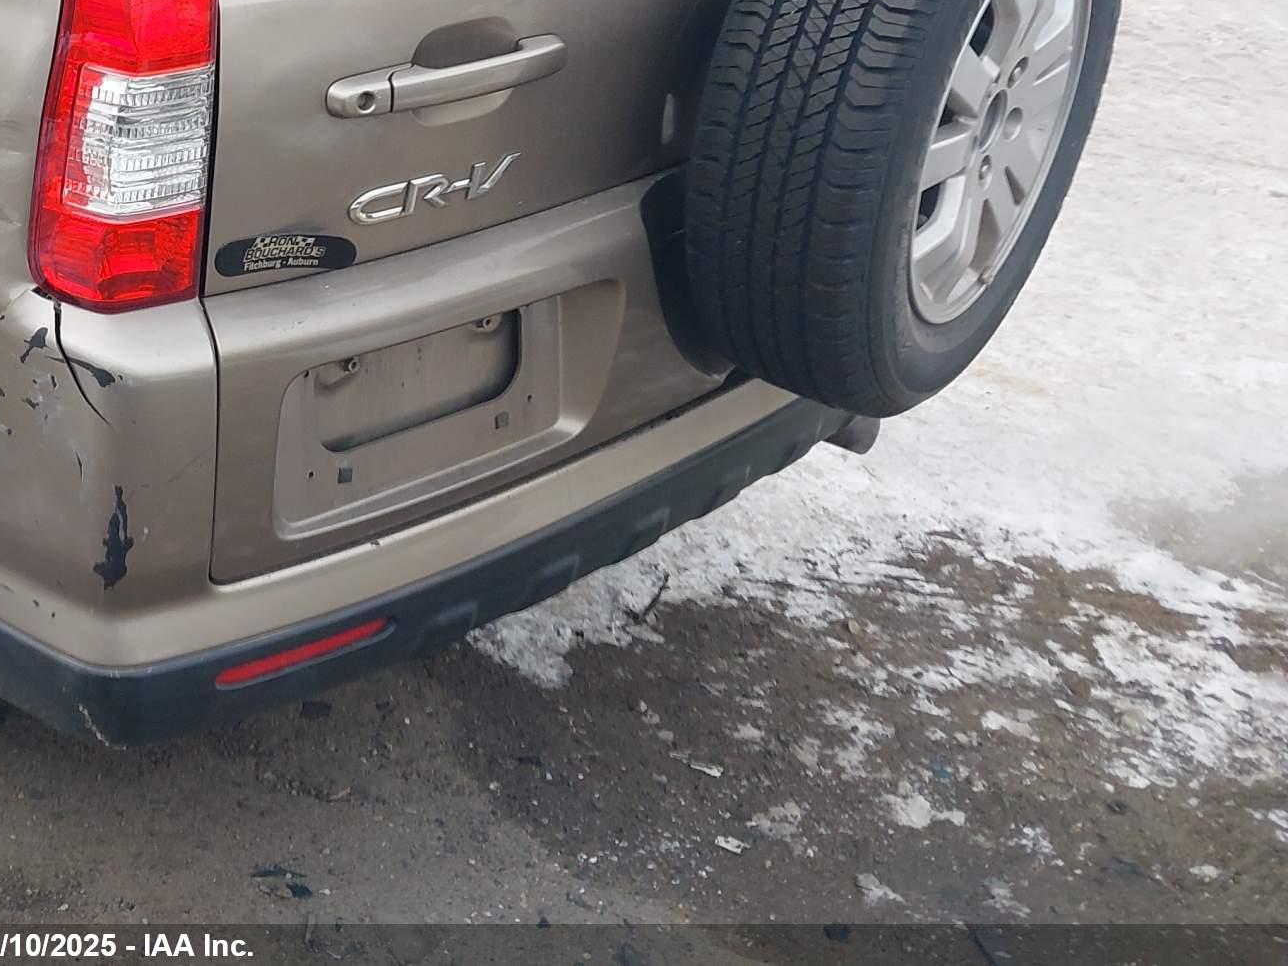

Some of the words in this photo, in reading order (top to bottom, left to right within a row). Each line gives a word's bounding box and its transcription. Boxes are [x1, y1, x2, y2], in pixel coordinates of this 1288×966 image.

[347, 152, 522, 226] CR-V
[267, 236, 297, 247] RON
[243, 246, 327, 262] BOUCHARD'S
[243, 260, 281, 271] Fitchburg
[287, 257, 319, 266] Auburn
